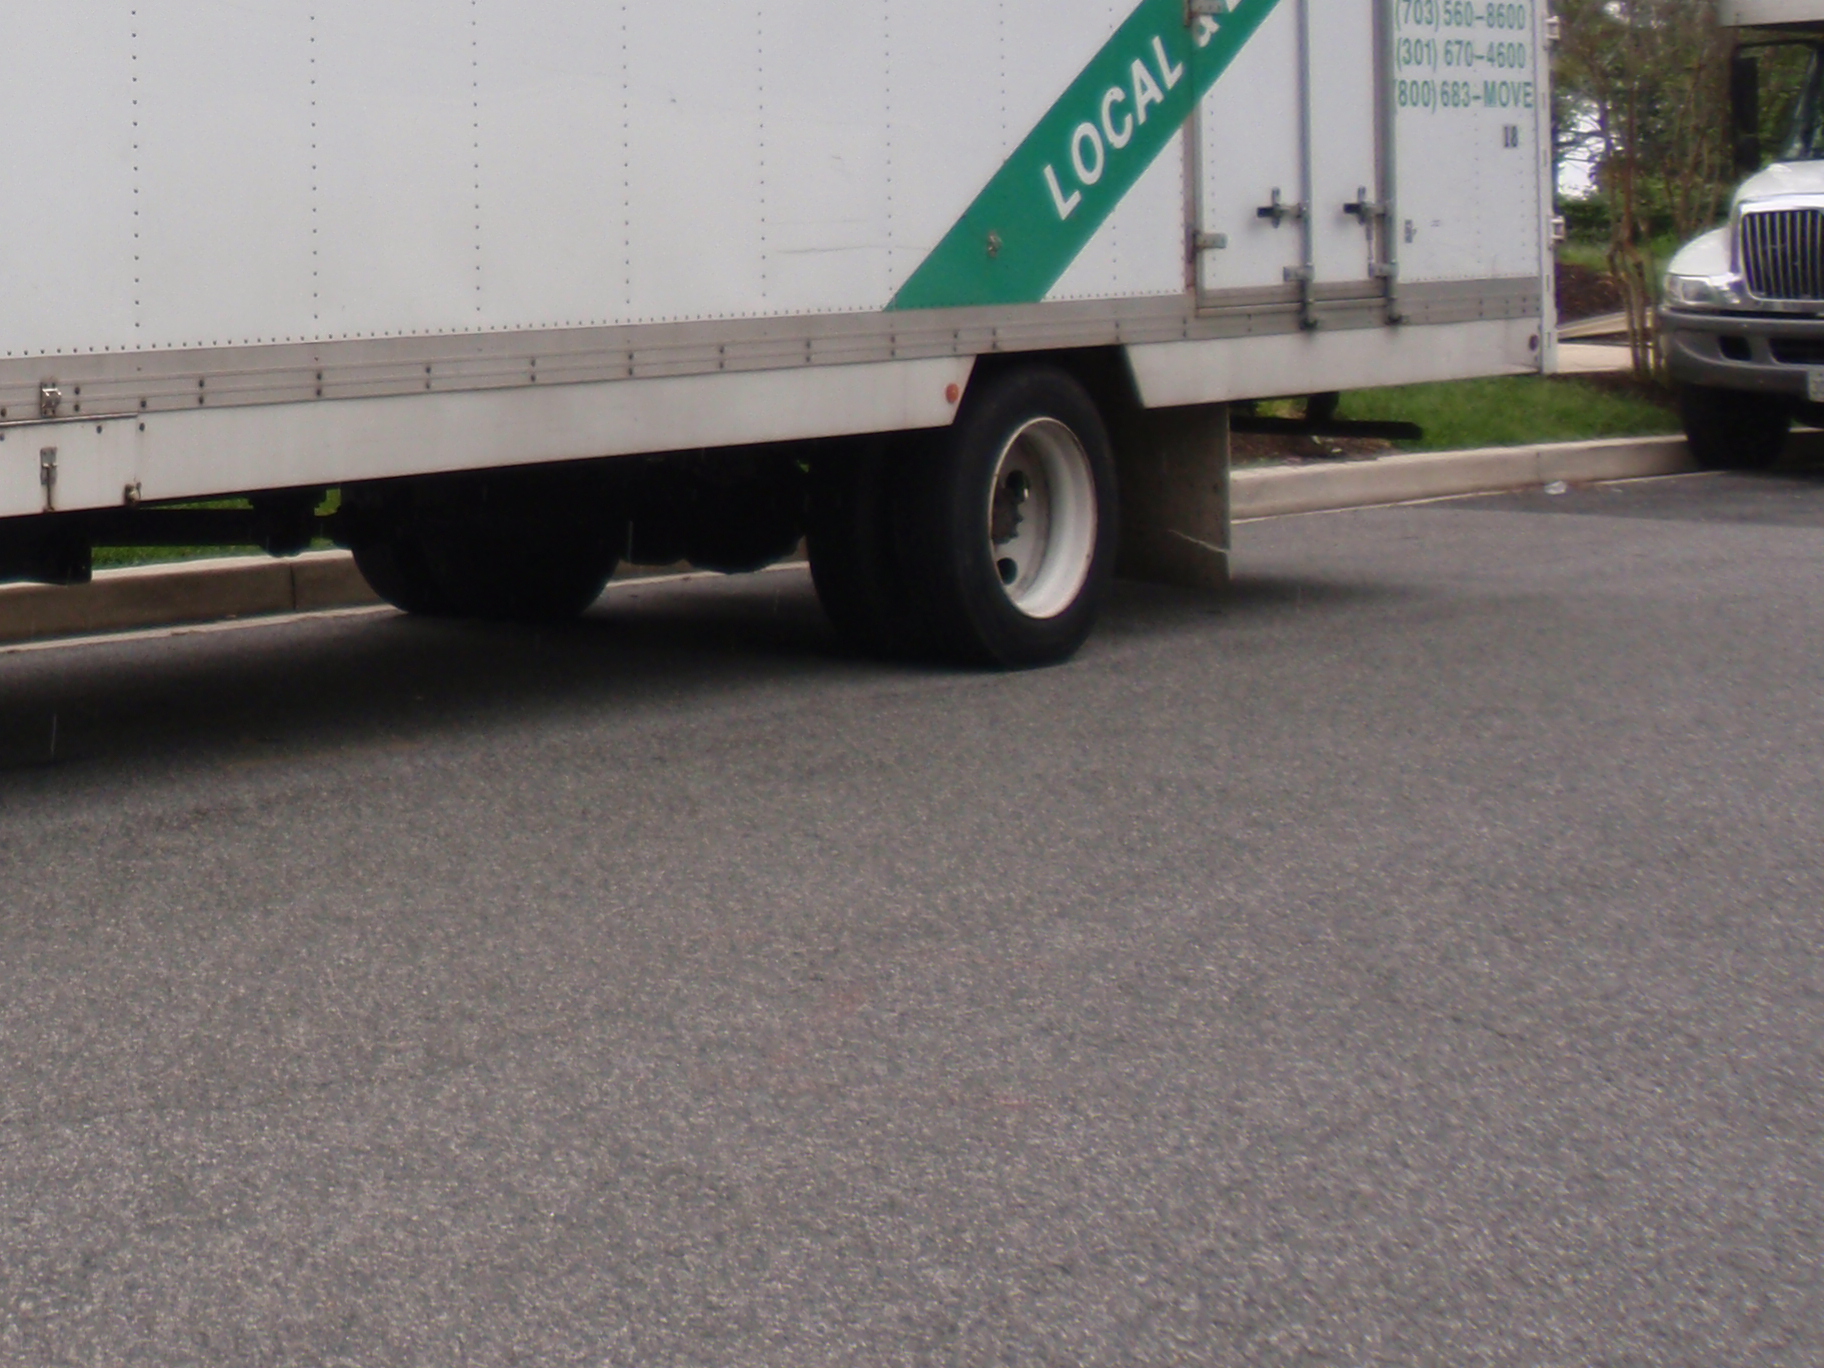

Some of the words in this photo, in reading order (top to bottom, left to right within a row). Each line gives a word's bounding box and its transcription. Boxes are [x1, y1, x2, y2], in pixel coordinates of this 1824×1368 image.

[1443, 0, 1526, 30] 560-8600
[1395, 37, 1438, 72] (301)
[1444, 39, 1526, 69] 670-4600
[1440, 80, 1534, 109] 683-MOVE
[1043, 36, 1184, 220] LOCAL
